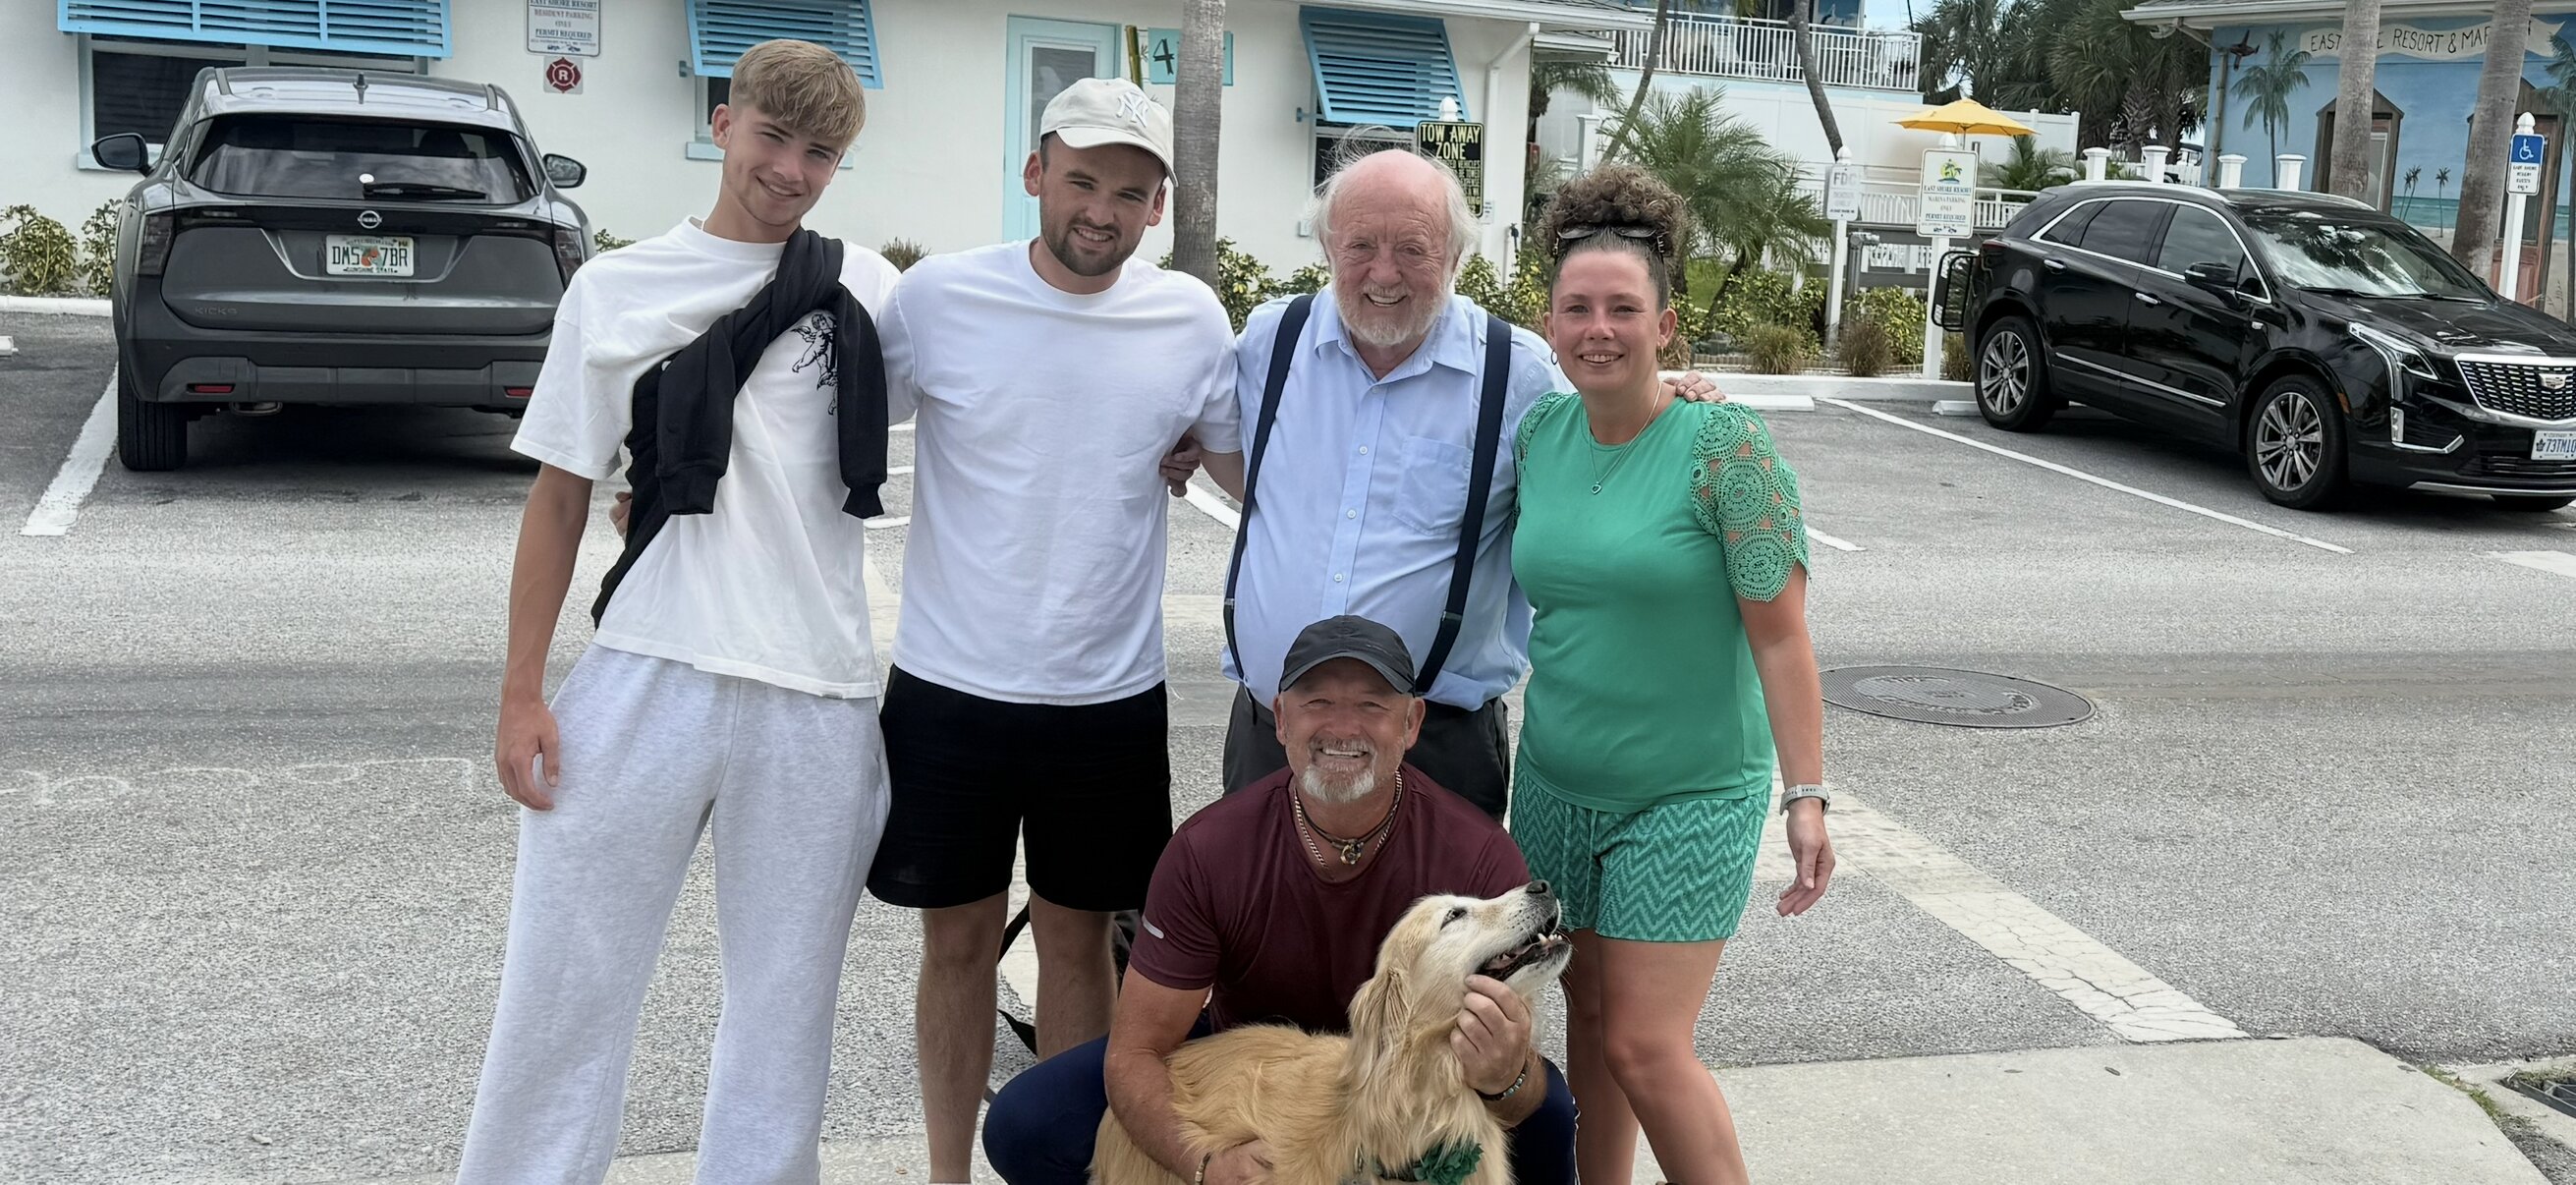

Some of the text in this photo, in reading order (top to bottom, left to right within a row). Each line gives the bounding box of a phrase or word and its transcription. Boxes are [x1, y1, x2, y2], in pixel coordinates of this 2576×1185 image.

[566, 11, 593, 20] PARKING
[2311, 33, 2342, 52] EAST
[2392, 28, 2444, 53] RESORT
[2447, 32, 2457, 54] &
[558, 69, 569, 81] R
[1116, 91, 1149, 128] NY
[1422, 124, 1482, 143] TOW AWAY
[1435, 141, 1467, 160] ZONE
